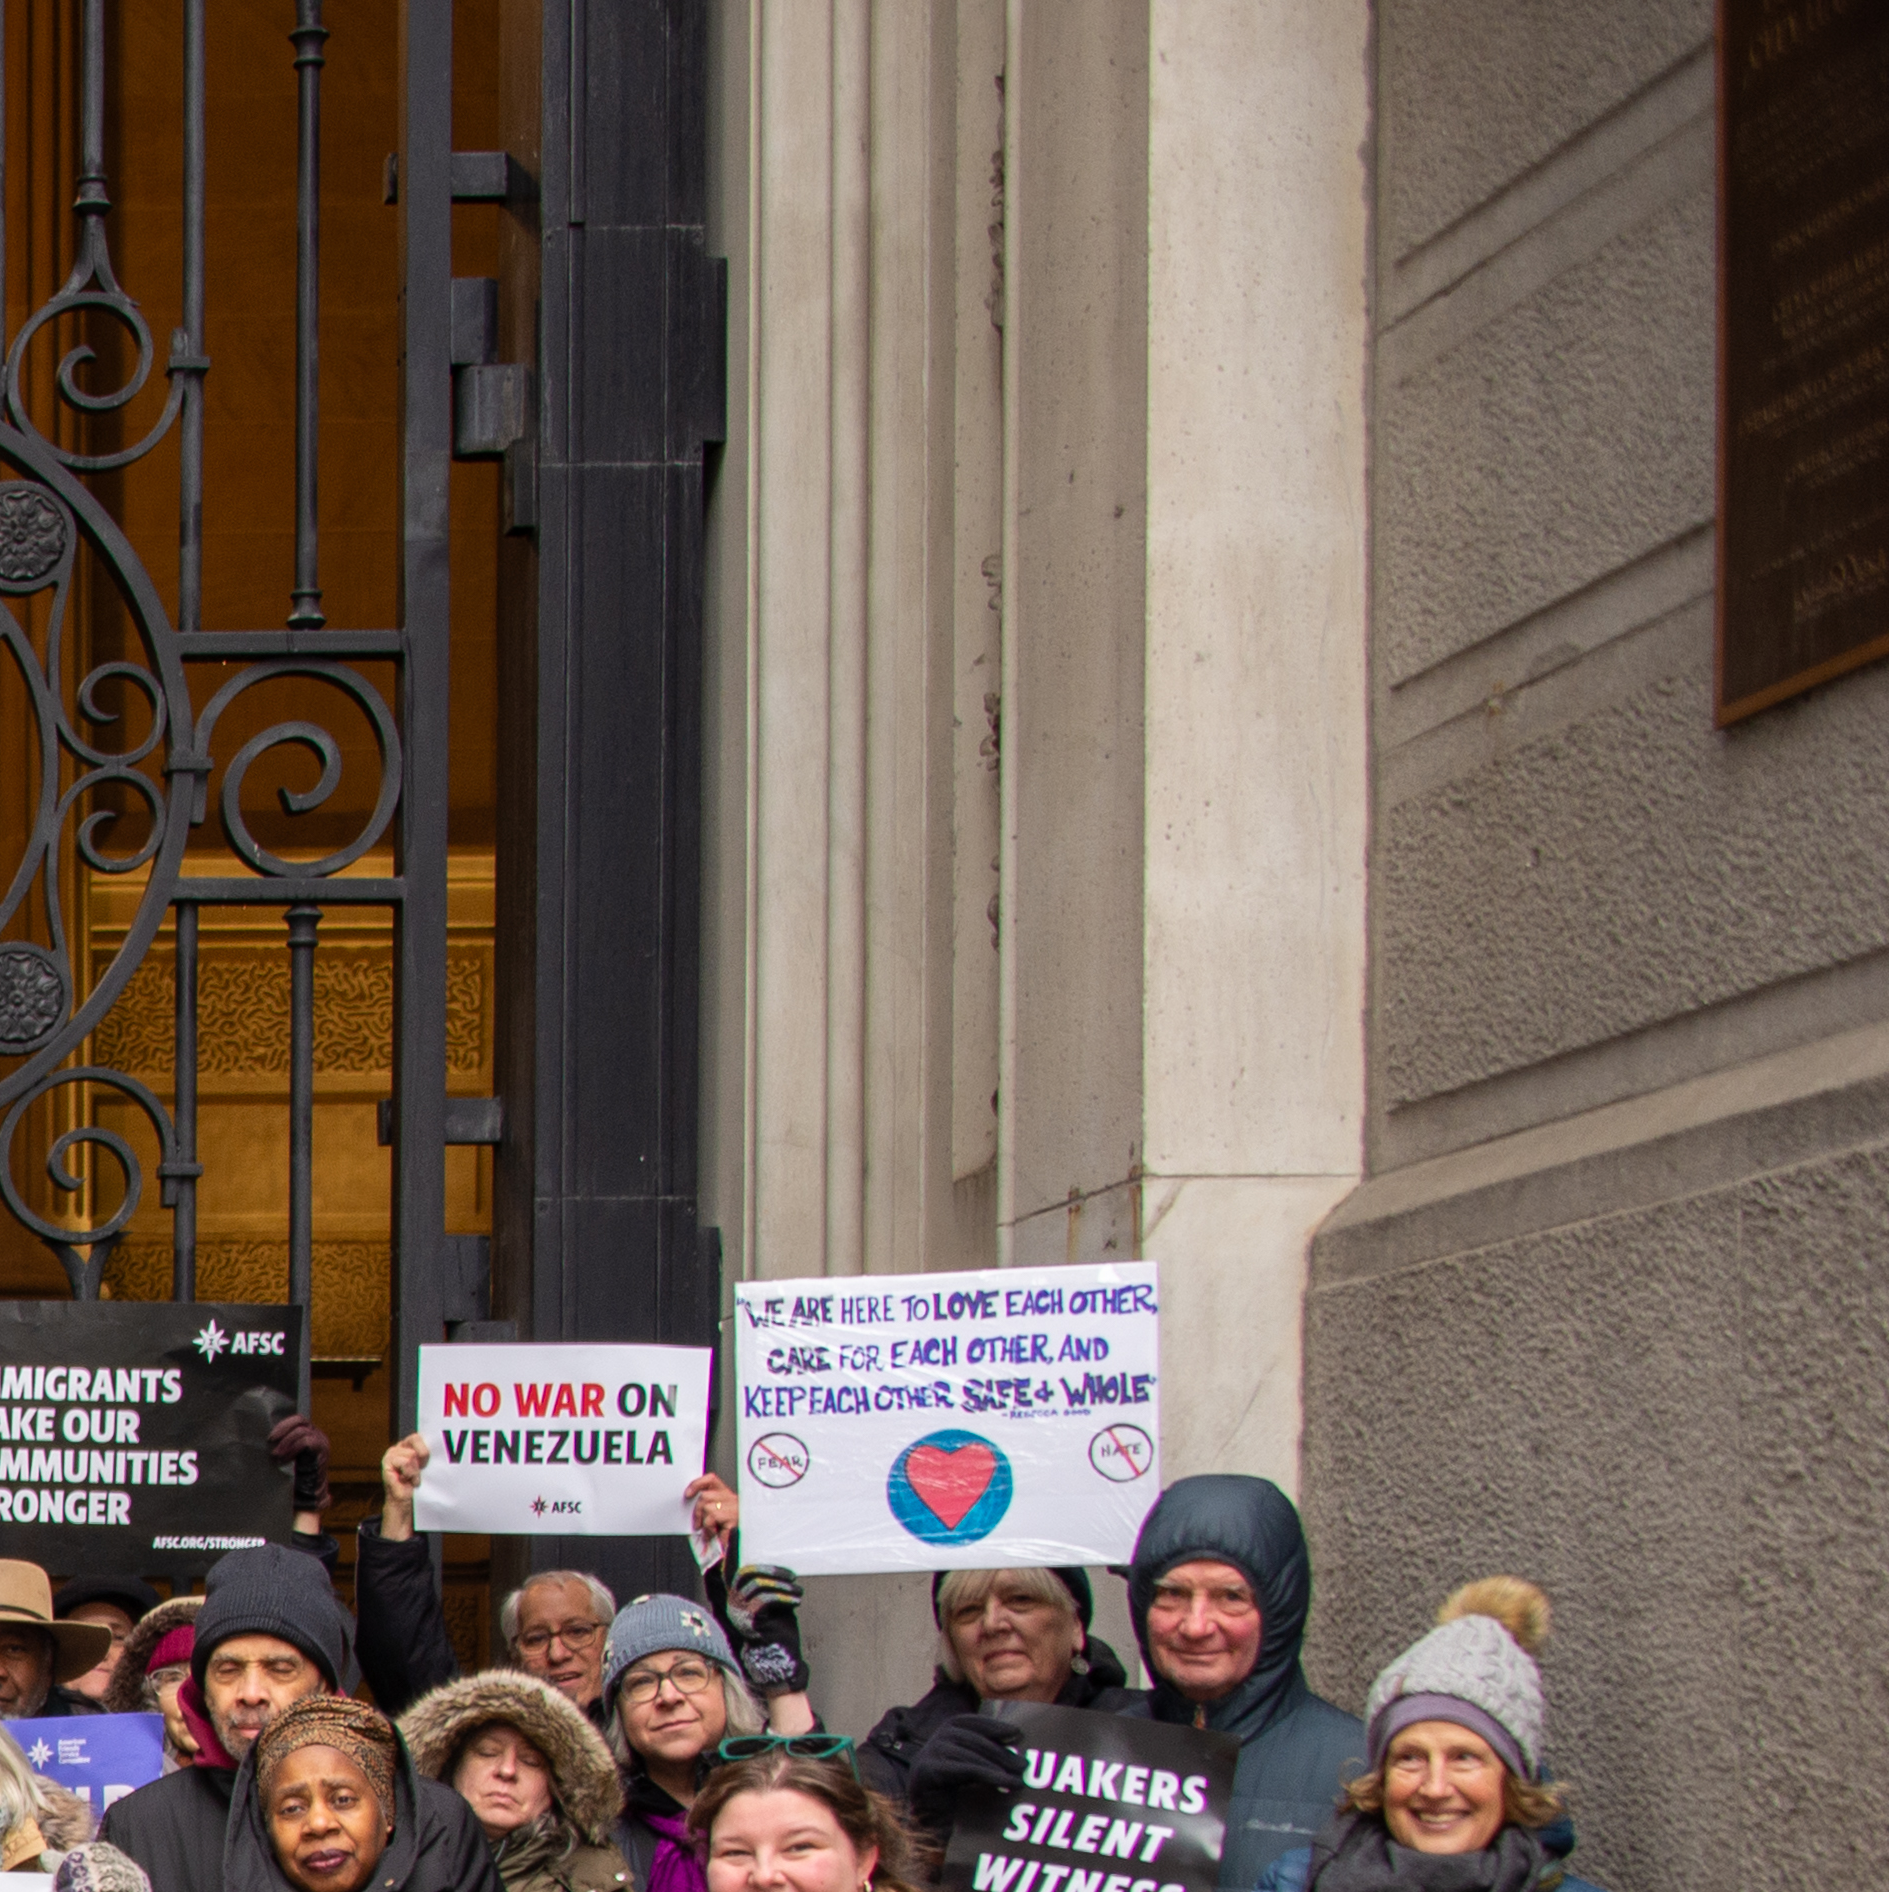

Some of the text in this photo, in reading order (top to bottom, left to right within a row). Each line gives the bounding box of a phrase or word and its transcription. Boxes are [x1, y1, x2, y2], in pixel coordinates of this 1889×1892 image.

[789, 1295, 834, 1327] ARE
[841, 1295, 895, 1324] HERE
[901, 1295, 930, 1322] TO
[933, 1290, 999, 1321] LOVE
[1005, 1288, 1064, 1317] EACH
[1069, 1284, 1158, 1315] OTHER,
[230, 1331, 286, 1355] AFSC
[767, 1334, 1110, 1376] CARE FOR EACH OTHER, AND
[443, 1382, 678, 1418] NO WAR ON
[744, 1385, 807, 1418] KEEP
[808, 1385, 871, 1415] EACH
[874, 1381, 955, 1411] OTHER
[960, 1378, 1033, 1413] SAFE
[62, 1407, 140, 1444] OUR
[442, 1429, 673, 1466] VENEZUELA
[758, 1455, 803, 1470] FEAR
[1102, 1443, 1141, 1457] HATE
[551, 1501, 582, 1514] AFSC
[1021, 1748, 1209, 1815] UAKERS
[1002, 1803, 1174, 1863] SILENT
